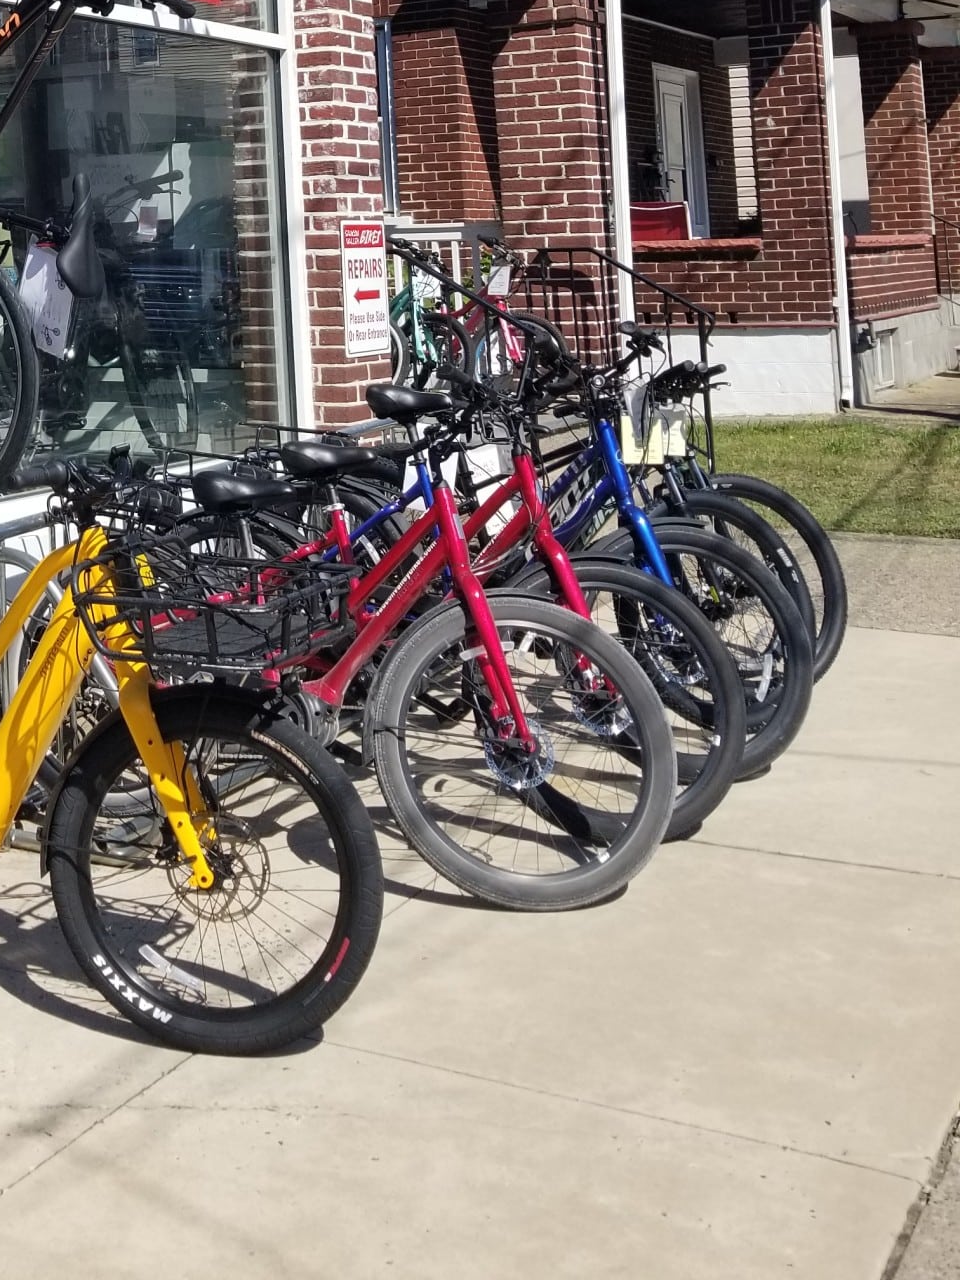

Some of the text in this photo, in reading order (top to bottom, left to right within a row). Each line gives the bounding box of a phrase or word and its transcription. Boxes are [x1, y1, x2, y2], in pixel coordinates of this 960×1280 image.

[359, 230, 381, 244] BIKES
[348, 258, 383, 279] REPAIRS
[350, 310, 385, 325] Please Use Side
[356, 329, 367, 341] Rear
[368, 326, 388, 340] Entrance
[93, 955, 172, 1023] MAXXIS
